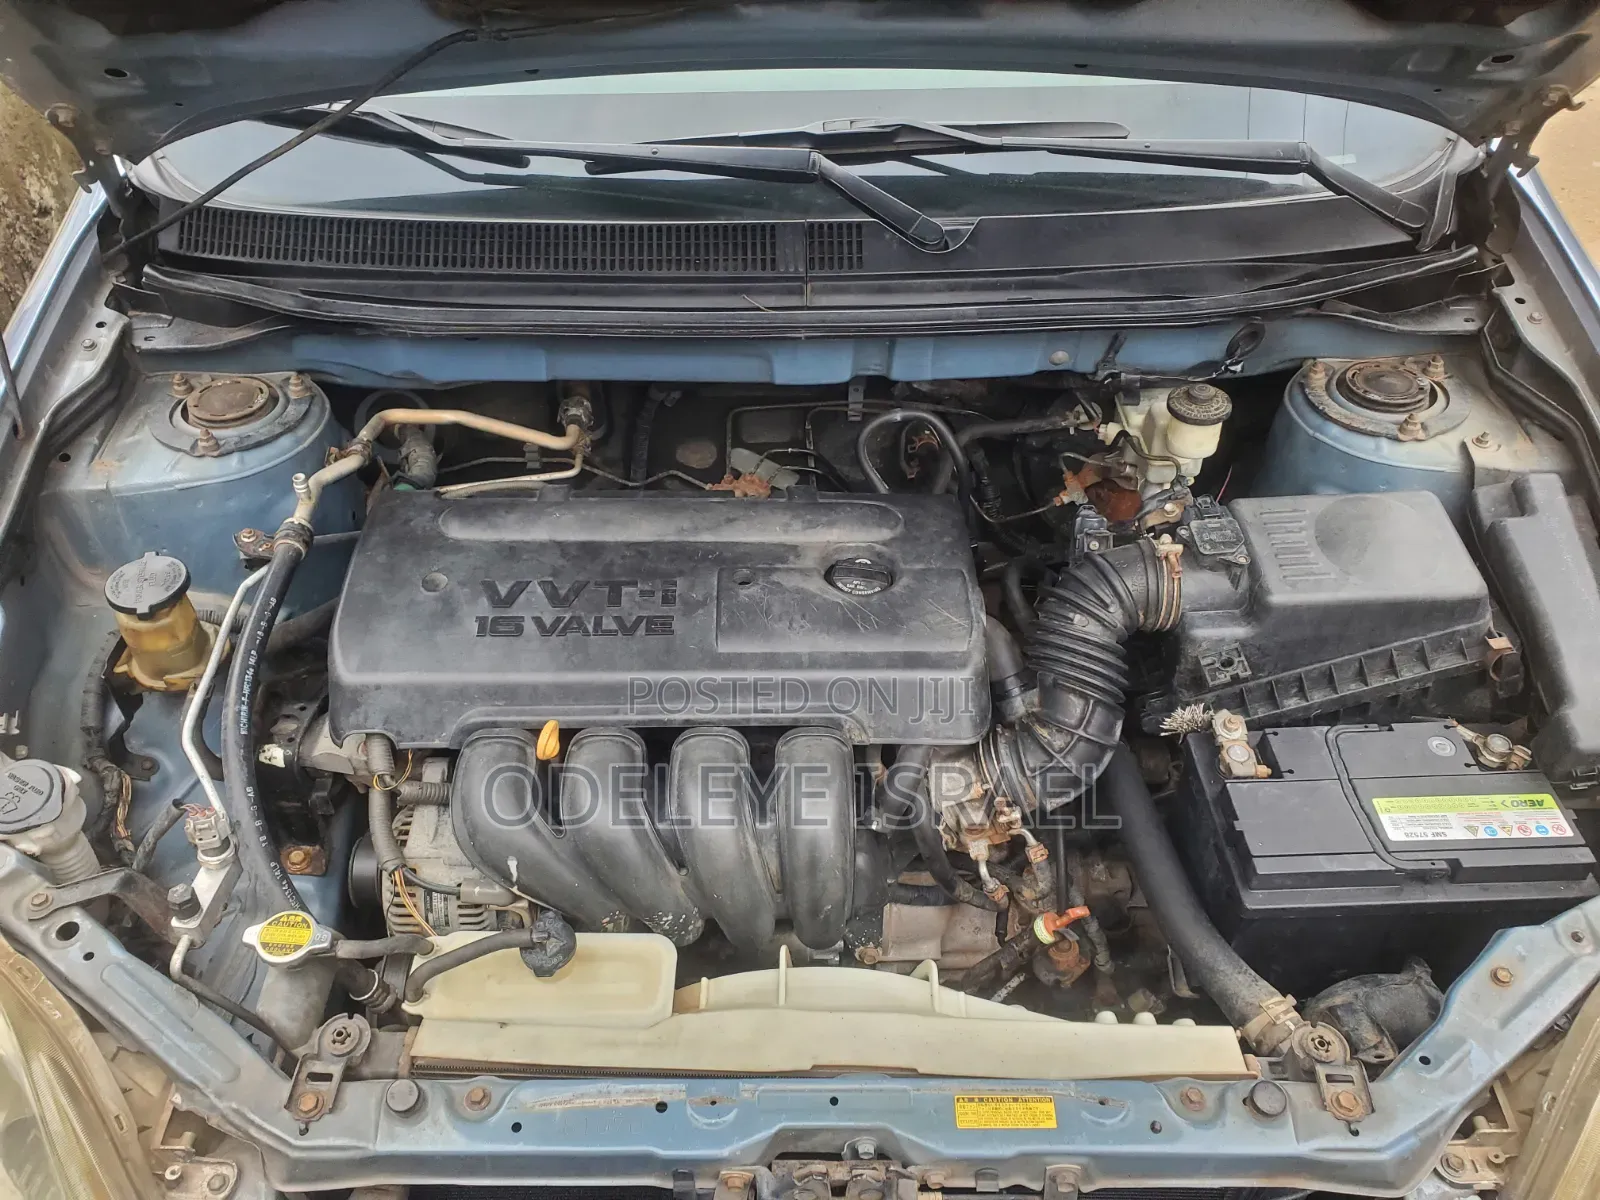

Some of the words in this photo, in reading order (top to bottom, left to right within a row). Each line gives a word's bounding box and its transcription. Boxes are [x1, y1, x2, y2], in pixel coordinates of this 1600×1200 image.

[475, 616, 525, 637] 16
[531, 616, 675, 637] VALVE
[1510, 799, 1545, 808] AERO
